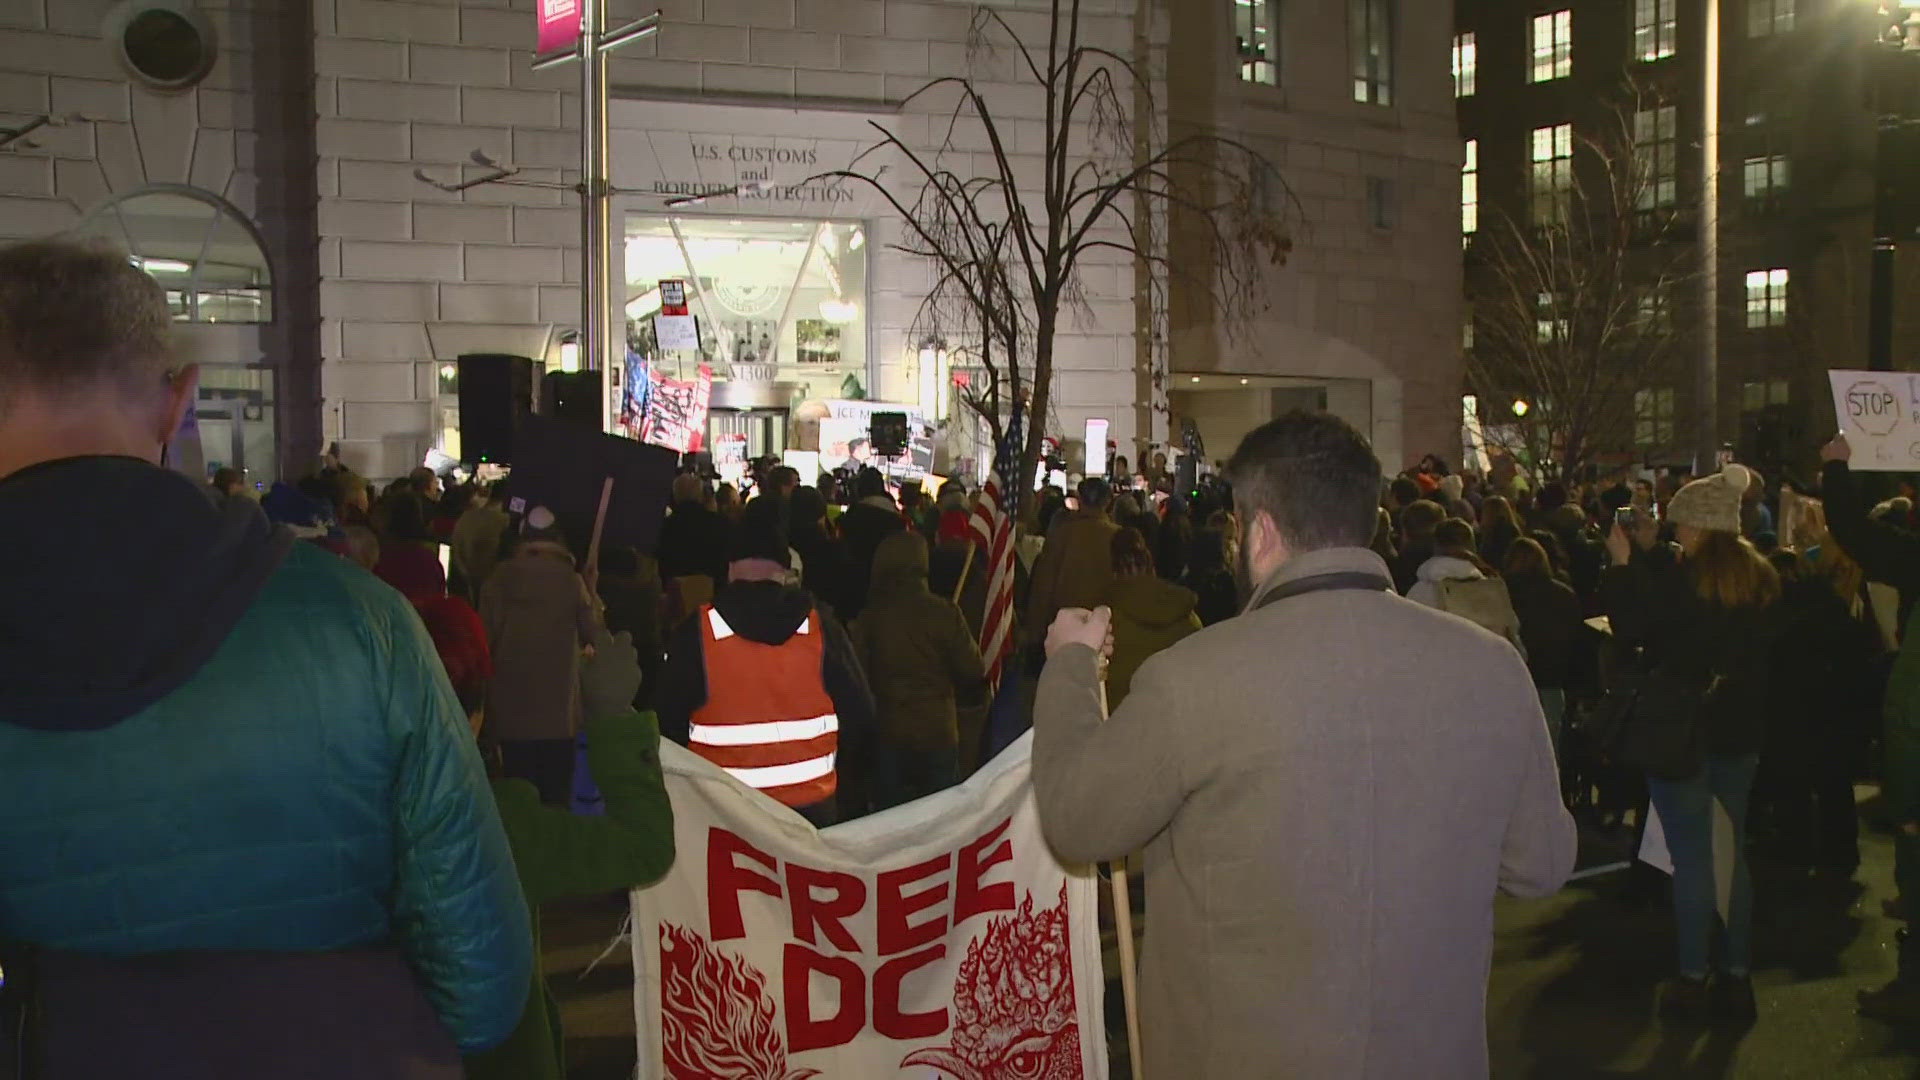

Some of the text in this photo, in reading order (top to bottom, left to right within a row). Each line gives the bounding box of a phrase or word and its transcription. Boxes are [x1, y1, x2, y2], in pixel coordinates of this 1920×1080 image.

[692, 145, 817, 164] U.S. CUSTOMS
[741, 166, 768, 181] and
[736, 184, 854, 202] ROTECTION
[740, 364, 772, 381] 1300
[1848, 393, 1893, 416] STOP
[707, 817, 1016, 956] FREE
[783, 943, 949, 1054] DC
